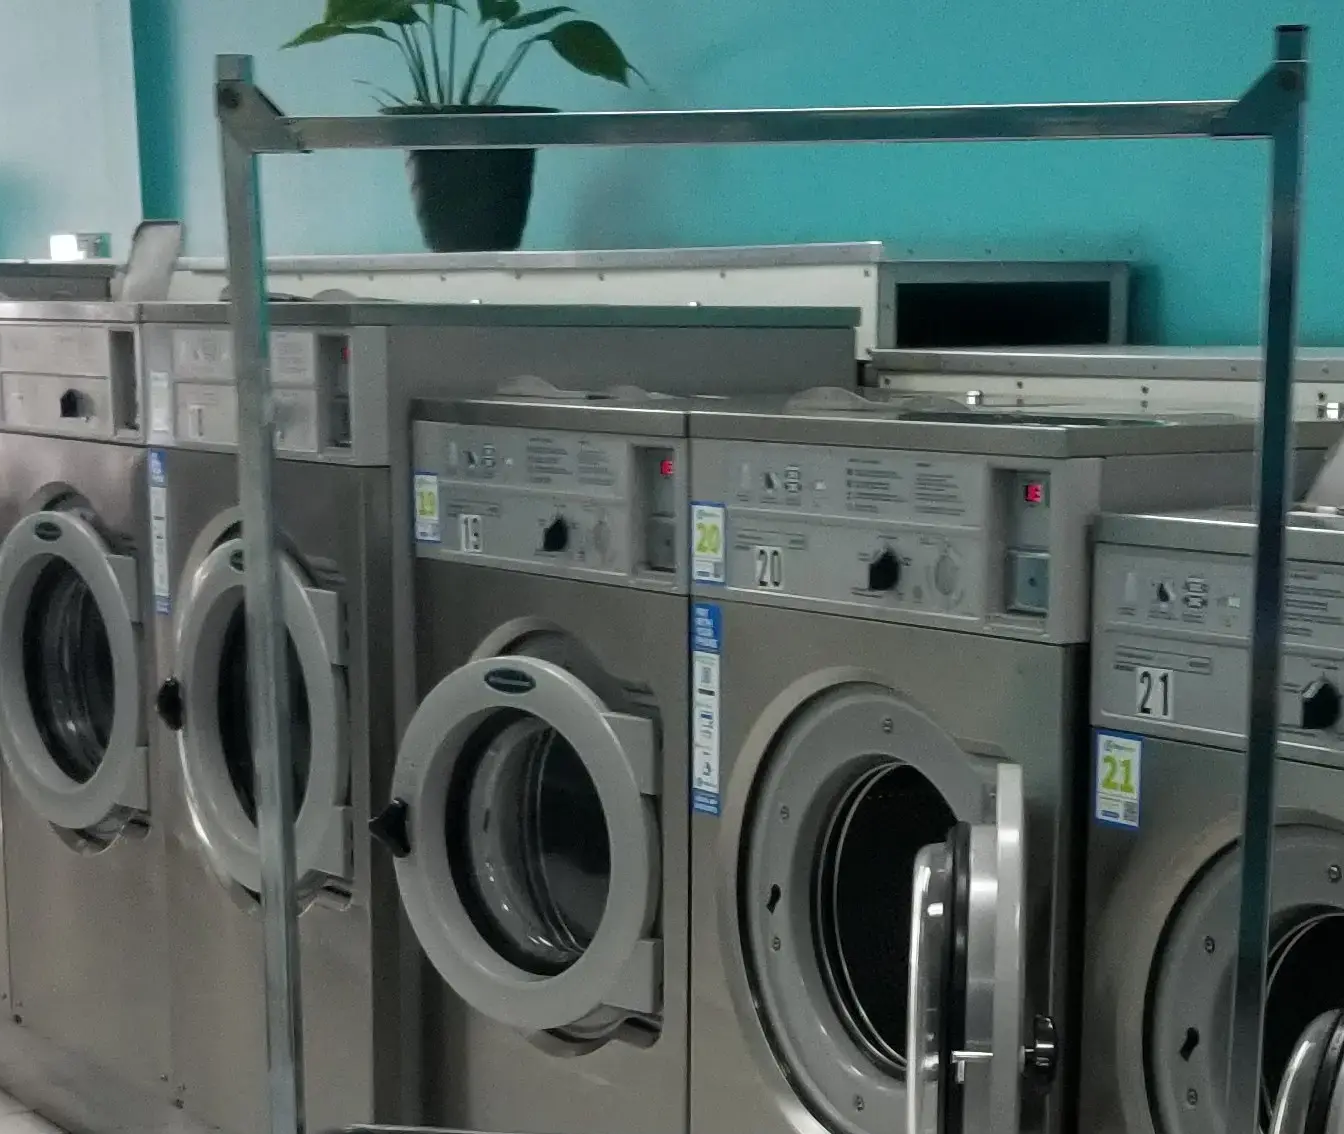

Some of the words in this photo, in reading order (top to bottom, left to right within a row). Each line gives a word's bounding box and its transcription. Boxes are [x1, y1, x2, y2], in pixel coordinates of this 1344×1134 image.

[696, 522, 721, 554] 20
[757, 548, 782, 587] 20
[1139, 670, 1169, 716] 21
[1102, 754, 1135, 793] 21
